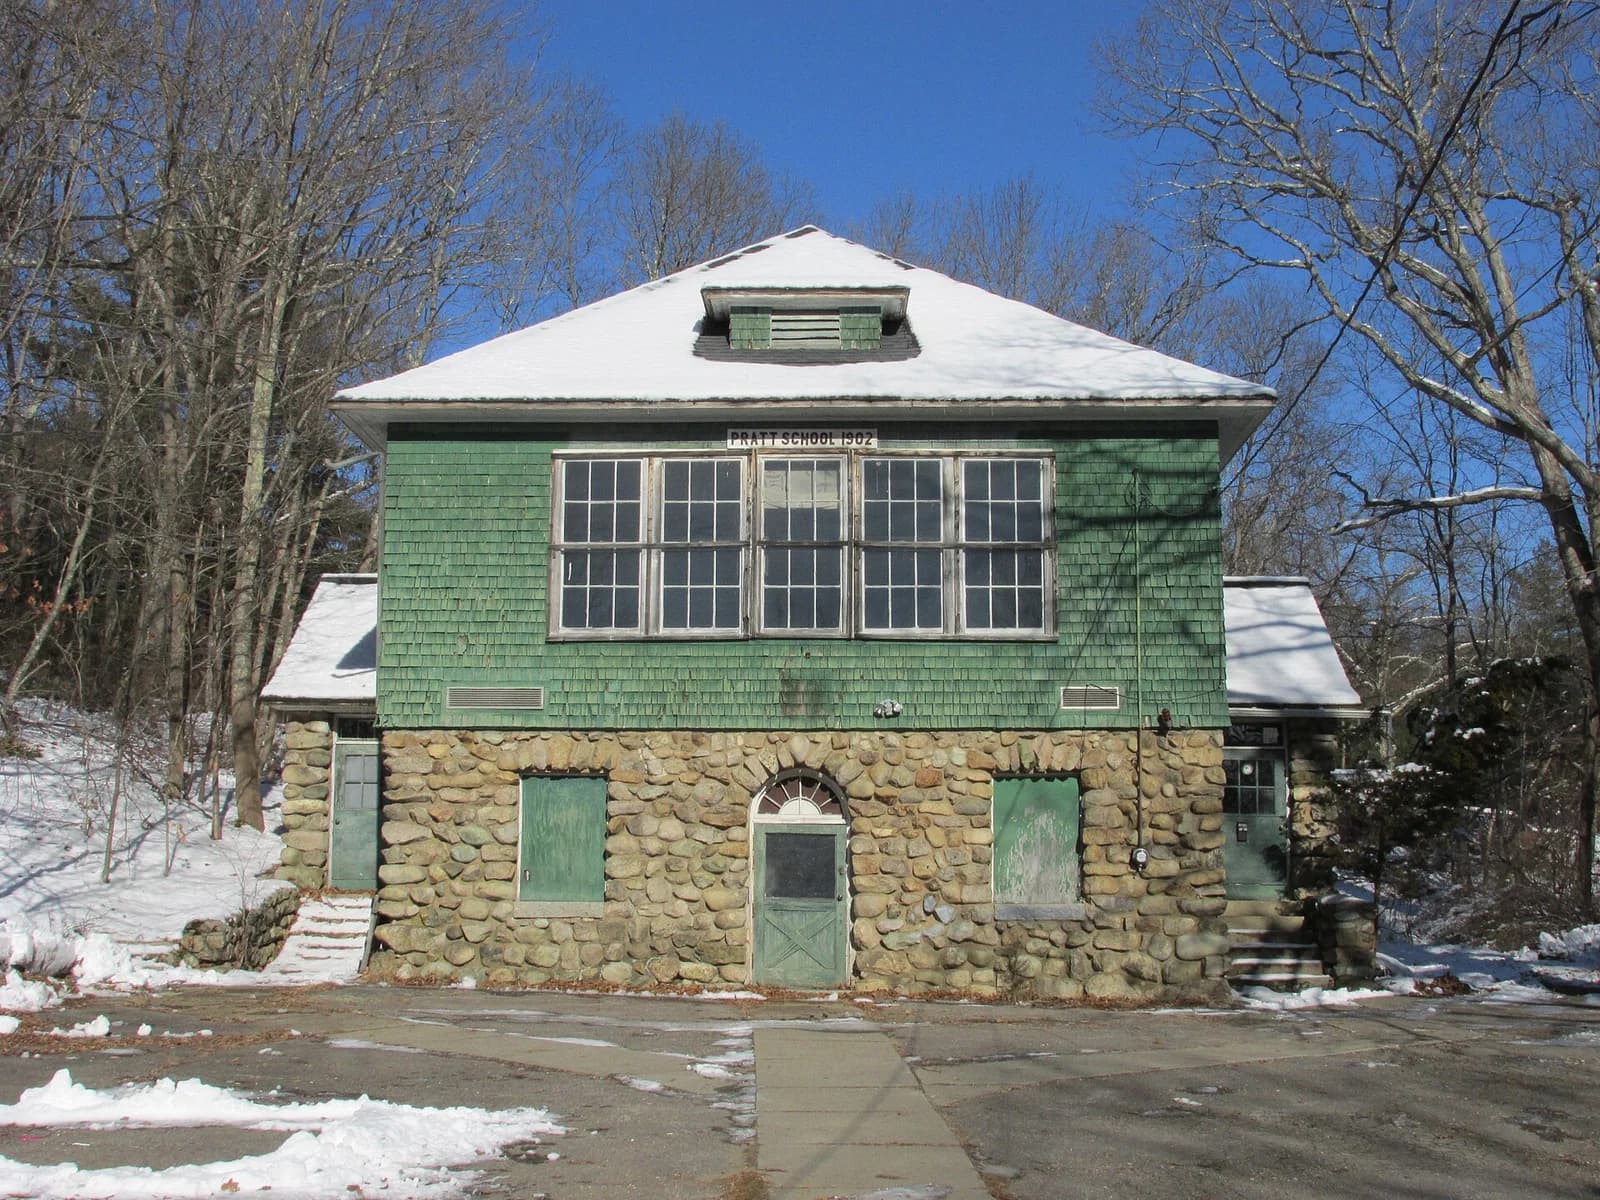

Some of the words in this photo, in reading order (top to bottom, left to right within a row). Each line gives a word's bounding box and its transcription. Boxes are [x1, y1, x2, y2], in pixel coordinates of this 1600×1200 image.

[731, 431, 778, 446] PRATT
[781, 431, 835, 446] SCHOOL
[841, 431, 873, 446] 1902
